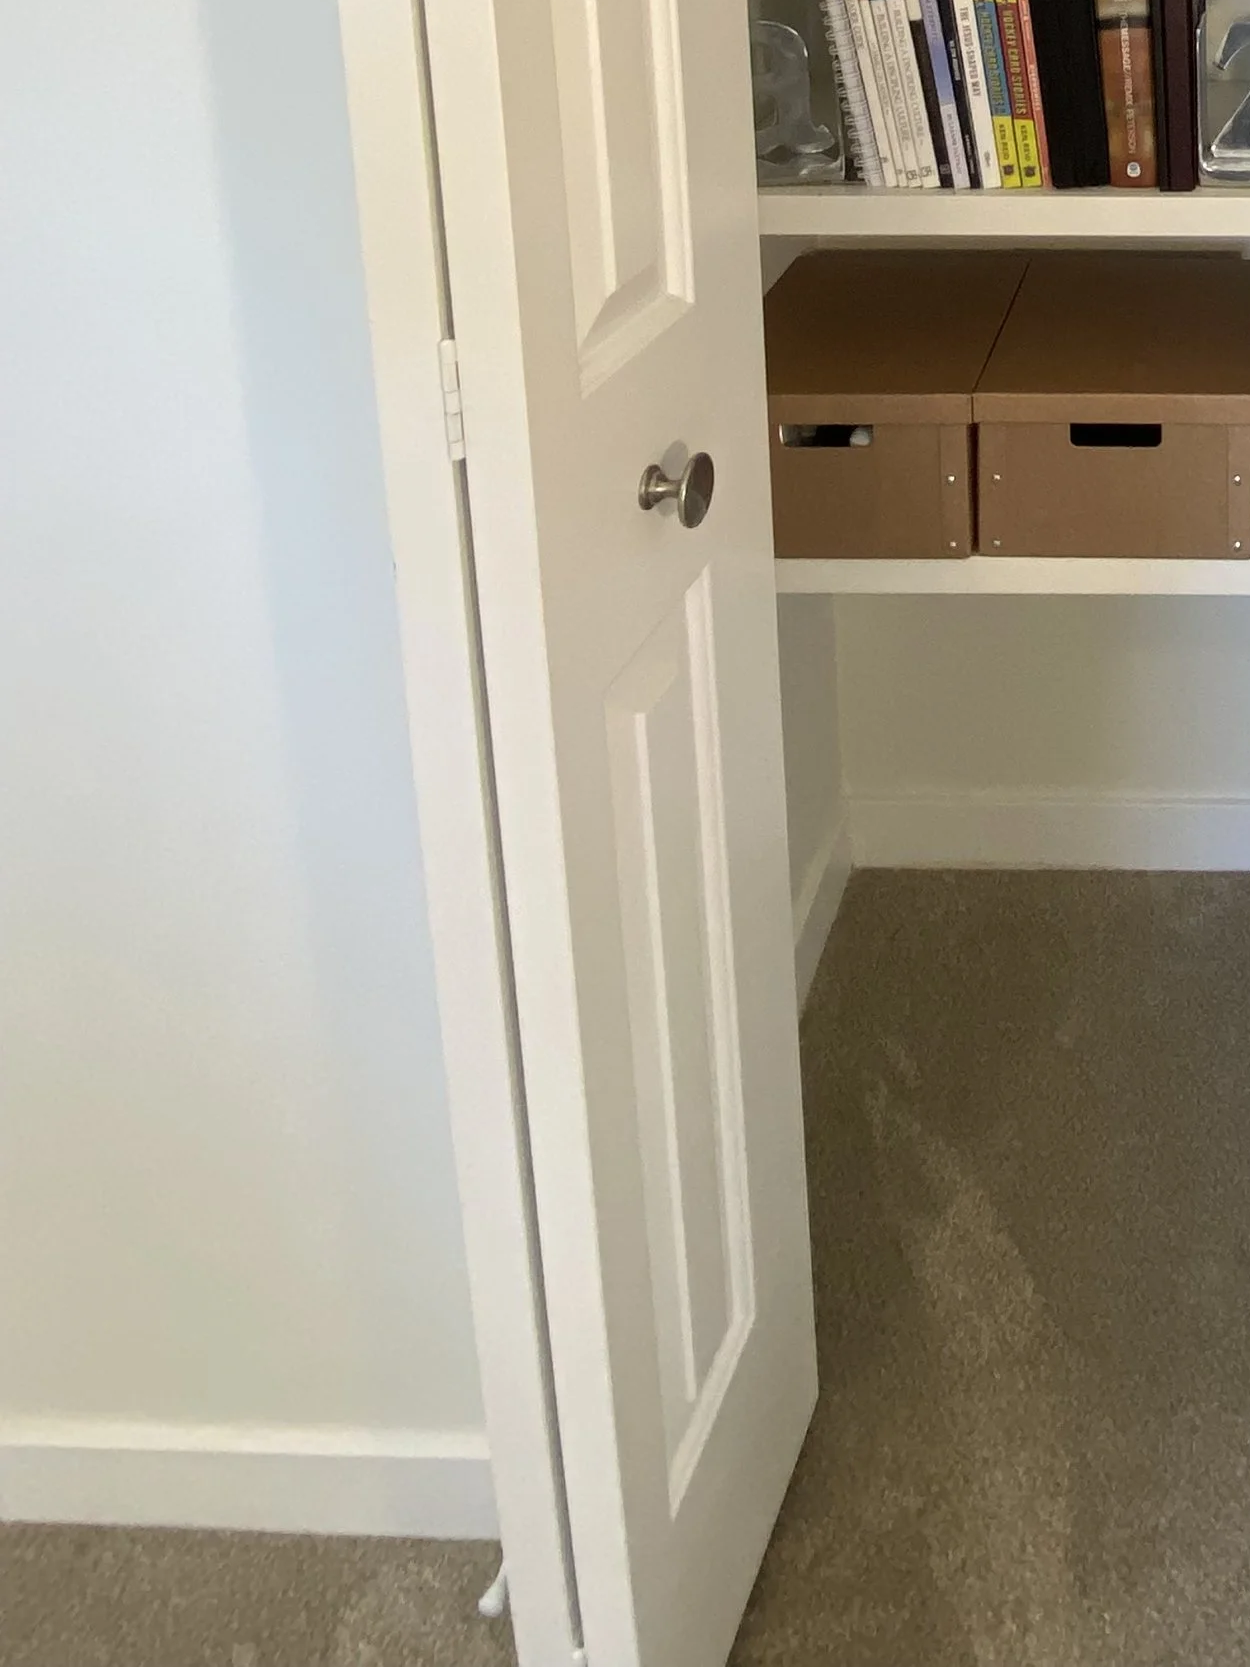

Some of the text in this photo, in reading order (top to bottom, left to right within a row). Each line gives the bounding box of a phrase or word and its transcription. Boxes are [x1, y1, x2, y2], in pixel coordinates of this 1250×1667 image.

[960, 7, 982, 98] THE JESUS-SHAPED WAY
[1003, 10, 1027, 115] HOCKEY CARD STORIES
[1126, 108, 1138, 154] PETERSON
